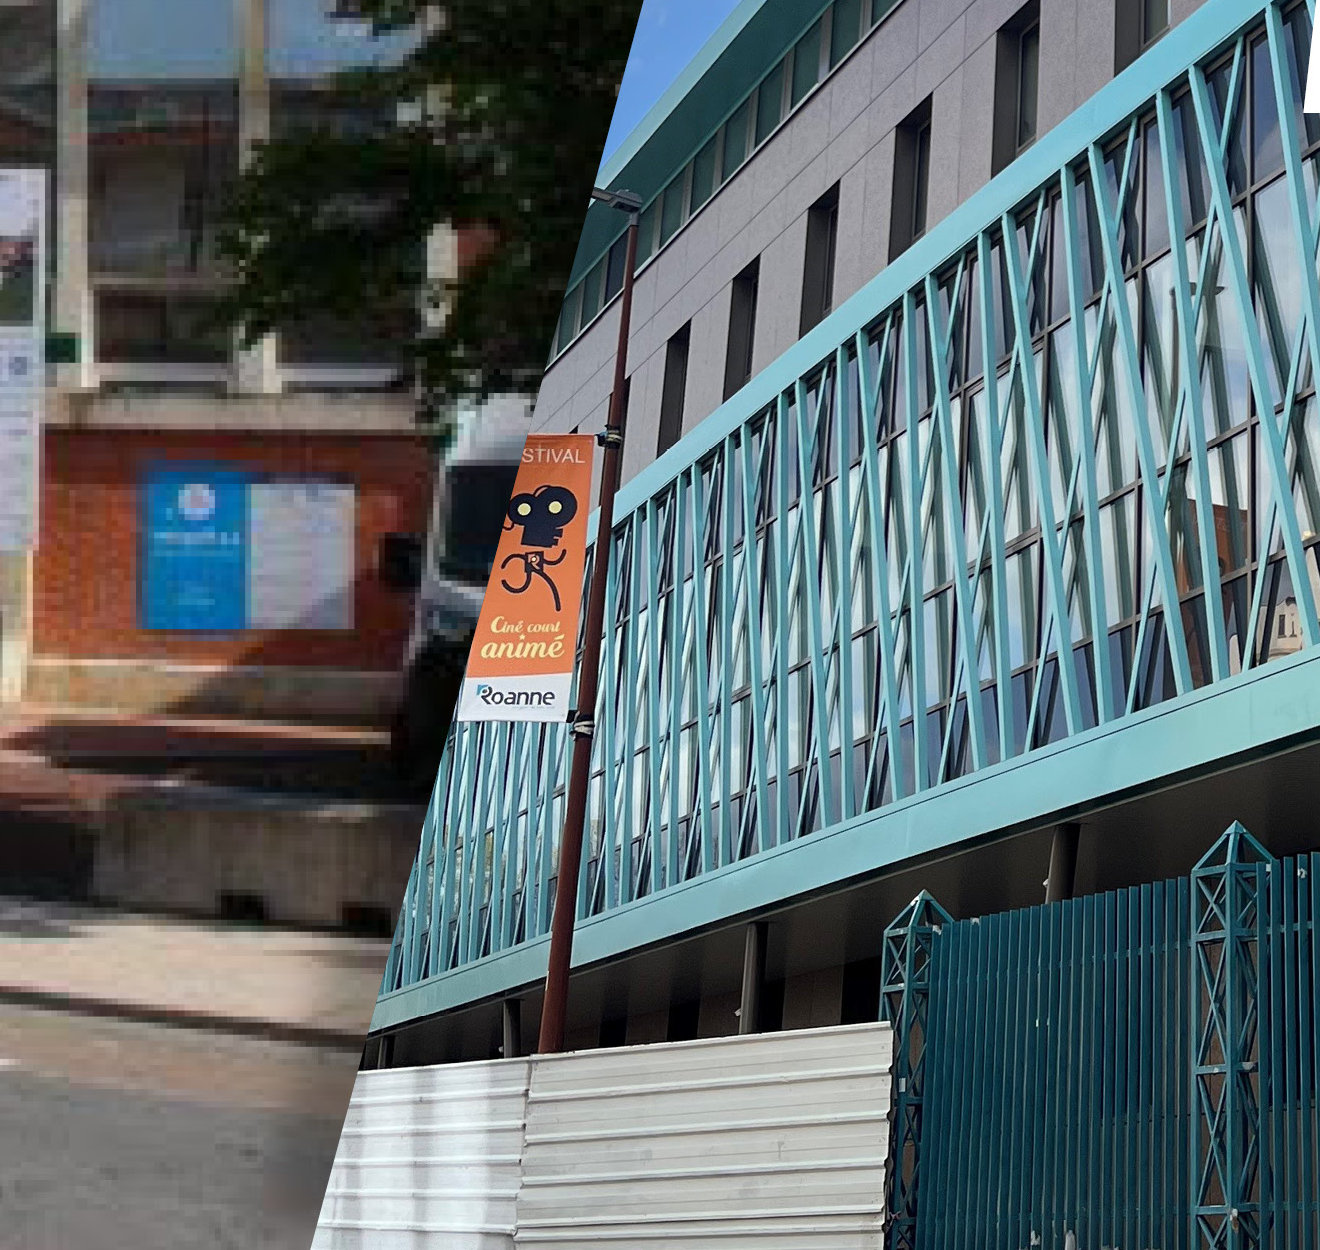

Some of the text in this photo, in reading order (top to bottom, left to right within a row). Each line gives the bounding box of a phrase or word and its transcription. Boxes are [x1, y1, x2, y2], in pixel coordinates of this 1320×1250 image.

[522, 448, 585, 463] STIVAL
[491, 616, 560, 633] Ciné court
[481, 634, 565, 659] animé
[477, 684, 555, 705] Roanne
